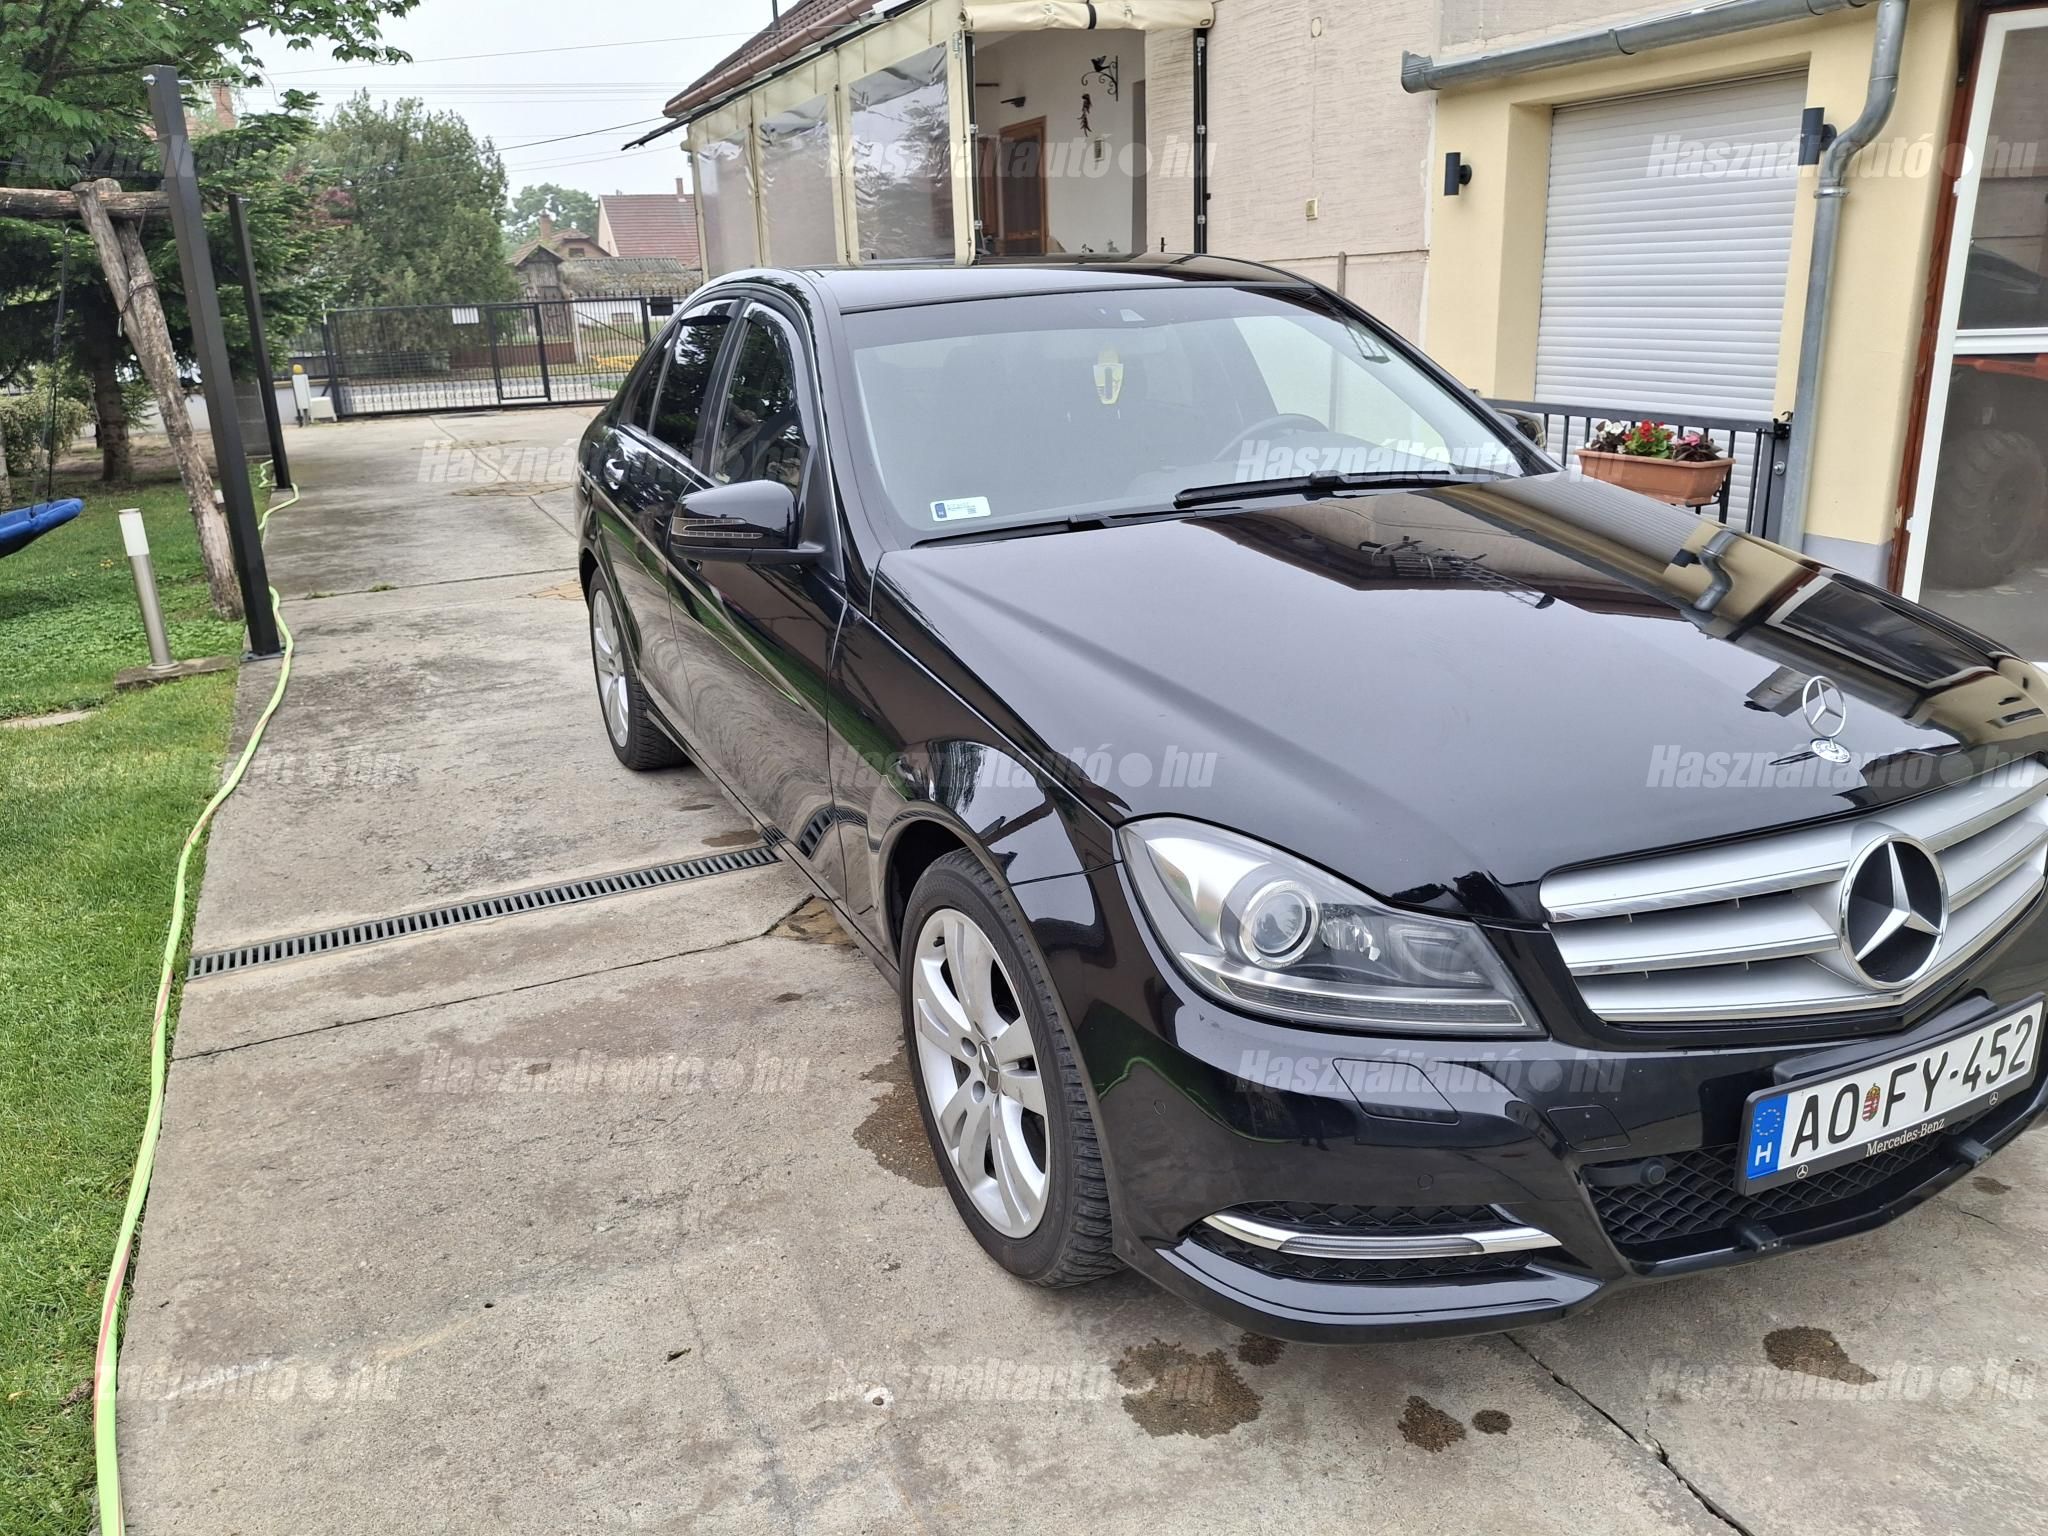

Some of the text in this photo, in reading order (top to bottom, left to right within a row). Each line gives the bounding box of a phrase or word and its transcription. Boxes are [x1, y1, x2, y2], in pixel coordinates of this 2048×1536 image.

[1790, 1014, 2034, 1158] AO FY-452
[1754, 1141, 1773, 1166] H
[1865, 1118, 1945, 1158] Mercedes-Benz
